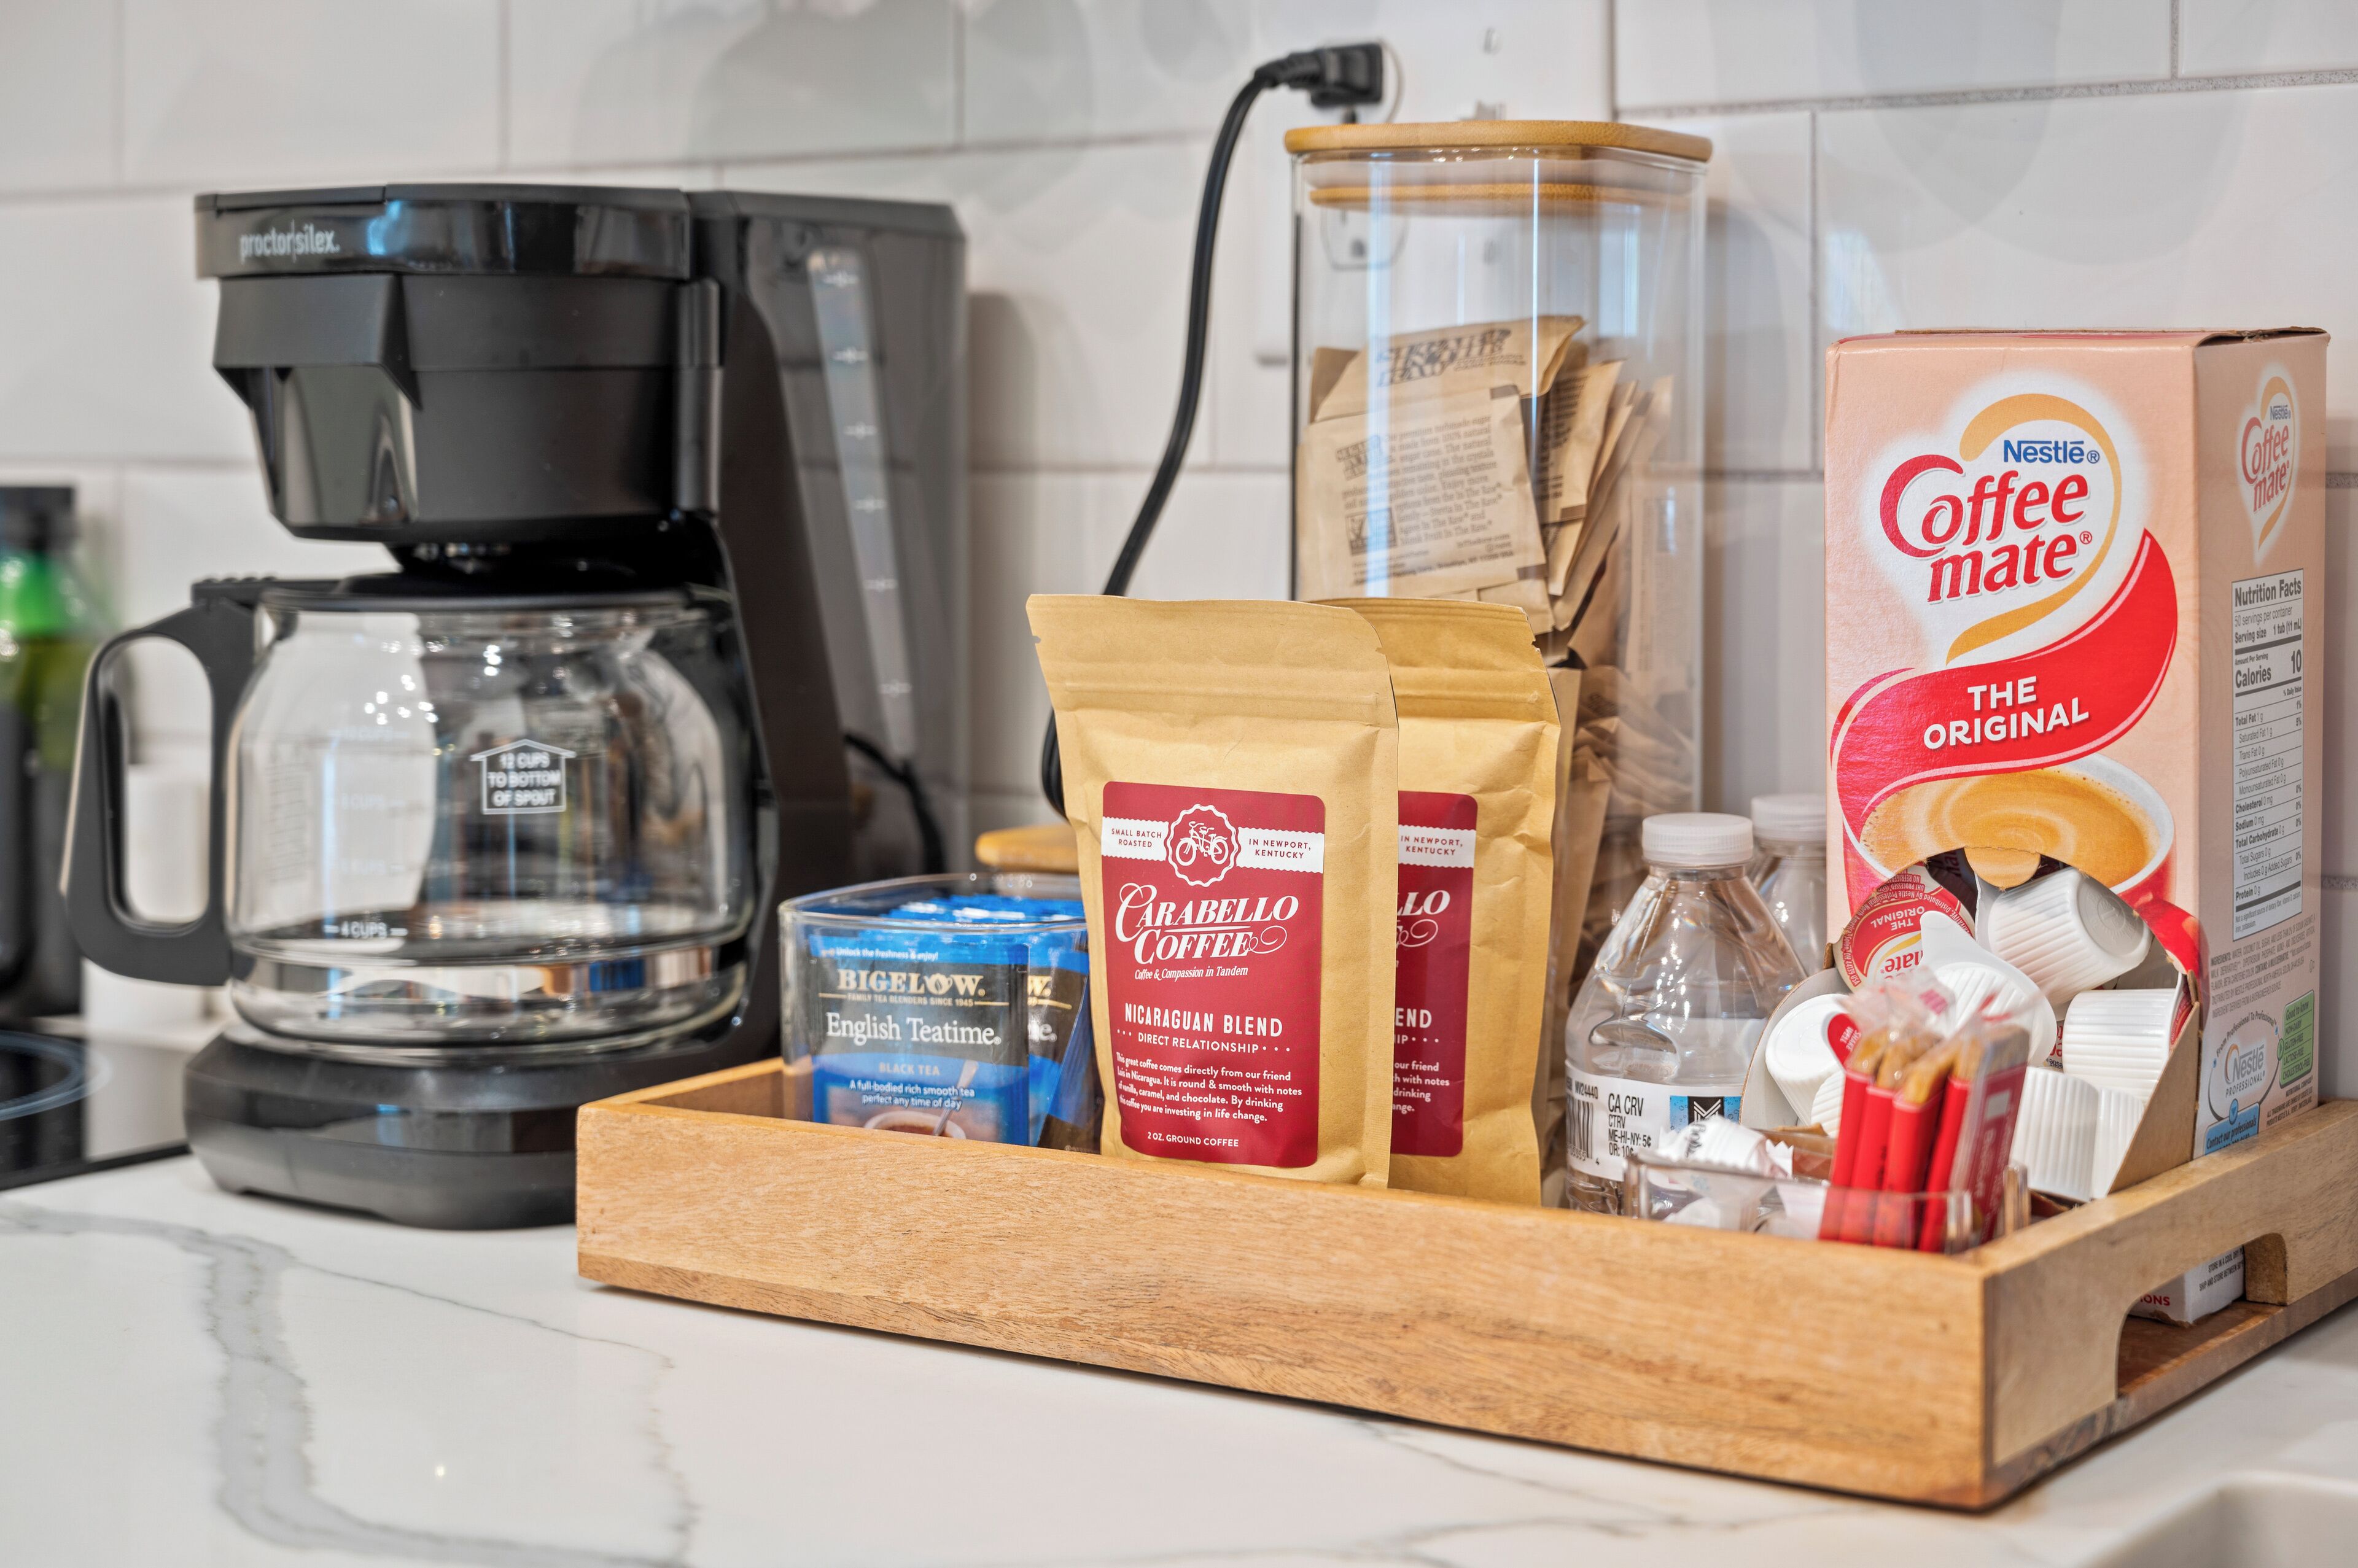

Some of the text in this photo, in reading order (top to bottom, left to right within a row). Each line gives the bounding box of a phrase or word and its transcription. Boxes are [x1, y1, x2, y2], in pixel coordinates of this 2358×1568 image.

[2241, 417, 2289, 485] Coffee
[1880, 454, 2088, 557] Coffee
[2235, 578, 2302, 607] Nutrition Facts
[2242, 612, 2262, 626] servings
[2273, 607, 2292, 619] container
[2235, 628, 2267, 643] Serving size
[2235, 650, 2302, 688] Calories 10
[1967, 675, 2037, 712] THE
[1923, 697, 2089, 750] ORIGINAL
[2236, 715, 2247, 726] Total
[500, 751, 550, 769] 12 CUPS
[488, 770, 561, 788] TO BOTTOM
[493, 789, 556, 806] OF SPOUT
[2236, 798, 2263, 813] Cholesterol
[2236, 818, 2253, 831] Sodium
[1118, 839, 1152, 848] ROASTED
[1137, 830, 1162, 839] BATCH
[1414, 837, 1463, 847] NEWPORT,
[2236, 828, 2278, 848] Total Carbohydrate
[1255, 849, 1304, 859] KENTUCKY
[1263, 840, 1312, 851] NEWPORT,
[1406, 846, 1455, 855] KENTUCKY
[2236, 888, 2253, 901] Protein
[1115, 883, 1299, 942] CARABELLO
[1870, 906, 1925, 928] ORIGINAL
[341, 921, 387, 939] 4 CUPS
[1891, 918, 1913, 931] THE
[836, 947, 860, 957] Unlock
[863, 948, 874, 958] the
[875, 949, 909, 960] freshness
[917, 951, 938, 961] enjoy!
[1134, 926, 1287, 964] COFFEE
[1135, 965, 1248, 981] Coffee & Compassion in Tandem
[847, 993, 872, 1001] FAMILY
[889, 995, 928, 1004] BLENDERS
[930, 997, 952, 1006] SINCE
[955, 998, 974, 1007] 1945
[1395, 1007, 1432, 1028] END
[2286, 1007, 2295, 1020] Good
[2300, 1001, 2309, 1012] know
[826, 1012, 902, 1046] English
[1125, 1003, 1283, 1037] NICARAGUAN BLEND
[2285, 1020, 2302, 1035] NON-DAIRY
[1138, 1032, 1259, 1054] DIRECT RELATIONSHIP
[2233, 1044, 2265, 1082] Nestlé
[2284, 1047, 2304, 1065] LACTOSE-FREE
[879, 1062, 940, 1076] BLACK TEA
[1126, 1058, 1138, 1067] great
[1140, 1059, 1158, 1069] coffee
[1184, 1064, 1218, 1079] directly
[1221, 1067, 1243, 1077] from
[1263, 1070, 1291, 1081] friend
[1412, 1061, 1439, 1071] friend
[850, 1079, 975, 1097] A full-bodied rich smooth tea
[1126, 1069, 1130, 1079] in
[1131, 1071, 1162, 1087] Nicaragua.
[1164, 1076, 1169, 1085] It
[1171, 1077, 1177, 1087] is
[1179, 1079, 1205, 1089] round
[1208, 1079, 1216, 1089] &
[1218, 1082, 1251, 1092] smooth
[1255, 1084, 1274, 1094] with
[1403, 1074, 1450, 1086] with notes
[863, 1094, 962, 1111] perfect any time of day
[1118, 1081, 1123, 1089] of
[1139, 1090, 1164, 1101] caramel,
[1166, 1092, 1180, 1101] and
[1181, 1093, 1228, 1104] chocolate.
[1231, 1095, 1243, 1108] By
[1245, 1096, 1283, 1112] drinking
[1393, 1087, 1431, 1102] drinking
[1126, 1098, 1140, 1109] coffee
[1141, 1103, 1151, 1113] you
[1165, 1105, 1200, 1120] investing
[1204, 1108, 1212, 1117] in
[1215, 1108, 1230, 1118] life
[1232, 1110, 1267, 1124] change.
[1608, 1093, 1644, 1117] CA CRV
[1609, 1114, 1625, 1128] CTRV
[1166, 1135, 1201, 1144] GROUND
[1204, 1138, 1239, 1147] COFFEE
[1609, 1128, 1651, 1148] ME-HI-NY: 5¢
[2207, 1133, 2223, 1149] Contact
[2231, 1116, 2257, 1141] professionals
[1609, 1143, 1620, 1157] OR:
